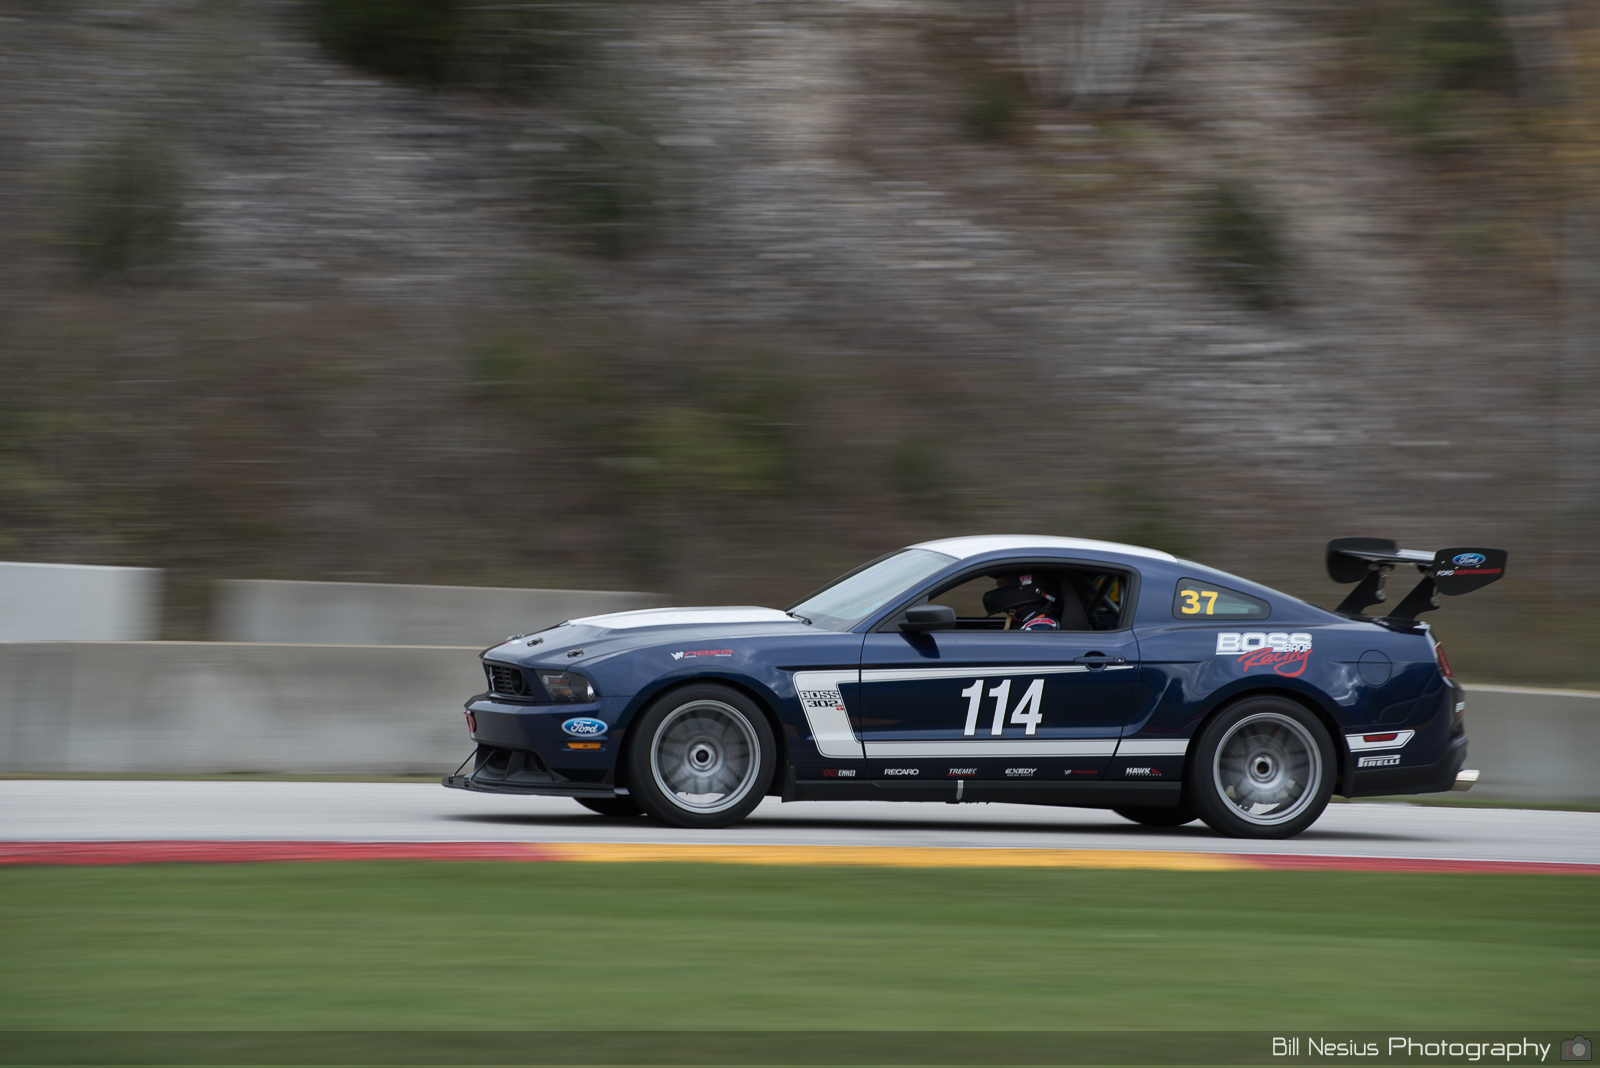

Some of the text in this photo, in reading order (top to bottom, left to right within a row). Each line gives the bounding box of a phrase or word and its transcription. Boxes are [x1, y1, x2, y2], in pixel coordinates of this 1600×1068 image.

[1180, 590, 1219, 615] 37
[1216, 632, 1313, 653] BOSS
[1237, 647, 1313, 678] Racing
[800, 691, 841, 699] BOSS
[961, 678, 1045, 736] 114
[570, 720, 599, 733] Ford
[1358, 754, 1401, 768] PIRELLI
[884, 768, 919, 776] RECARO
